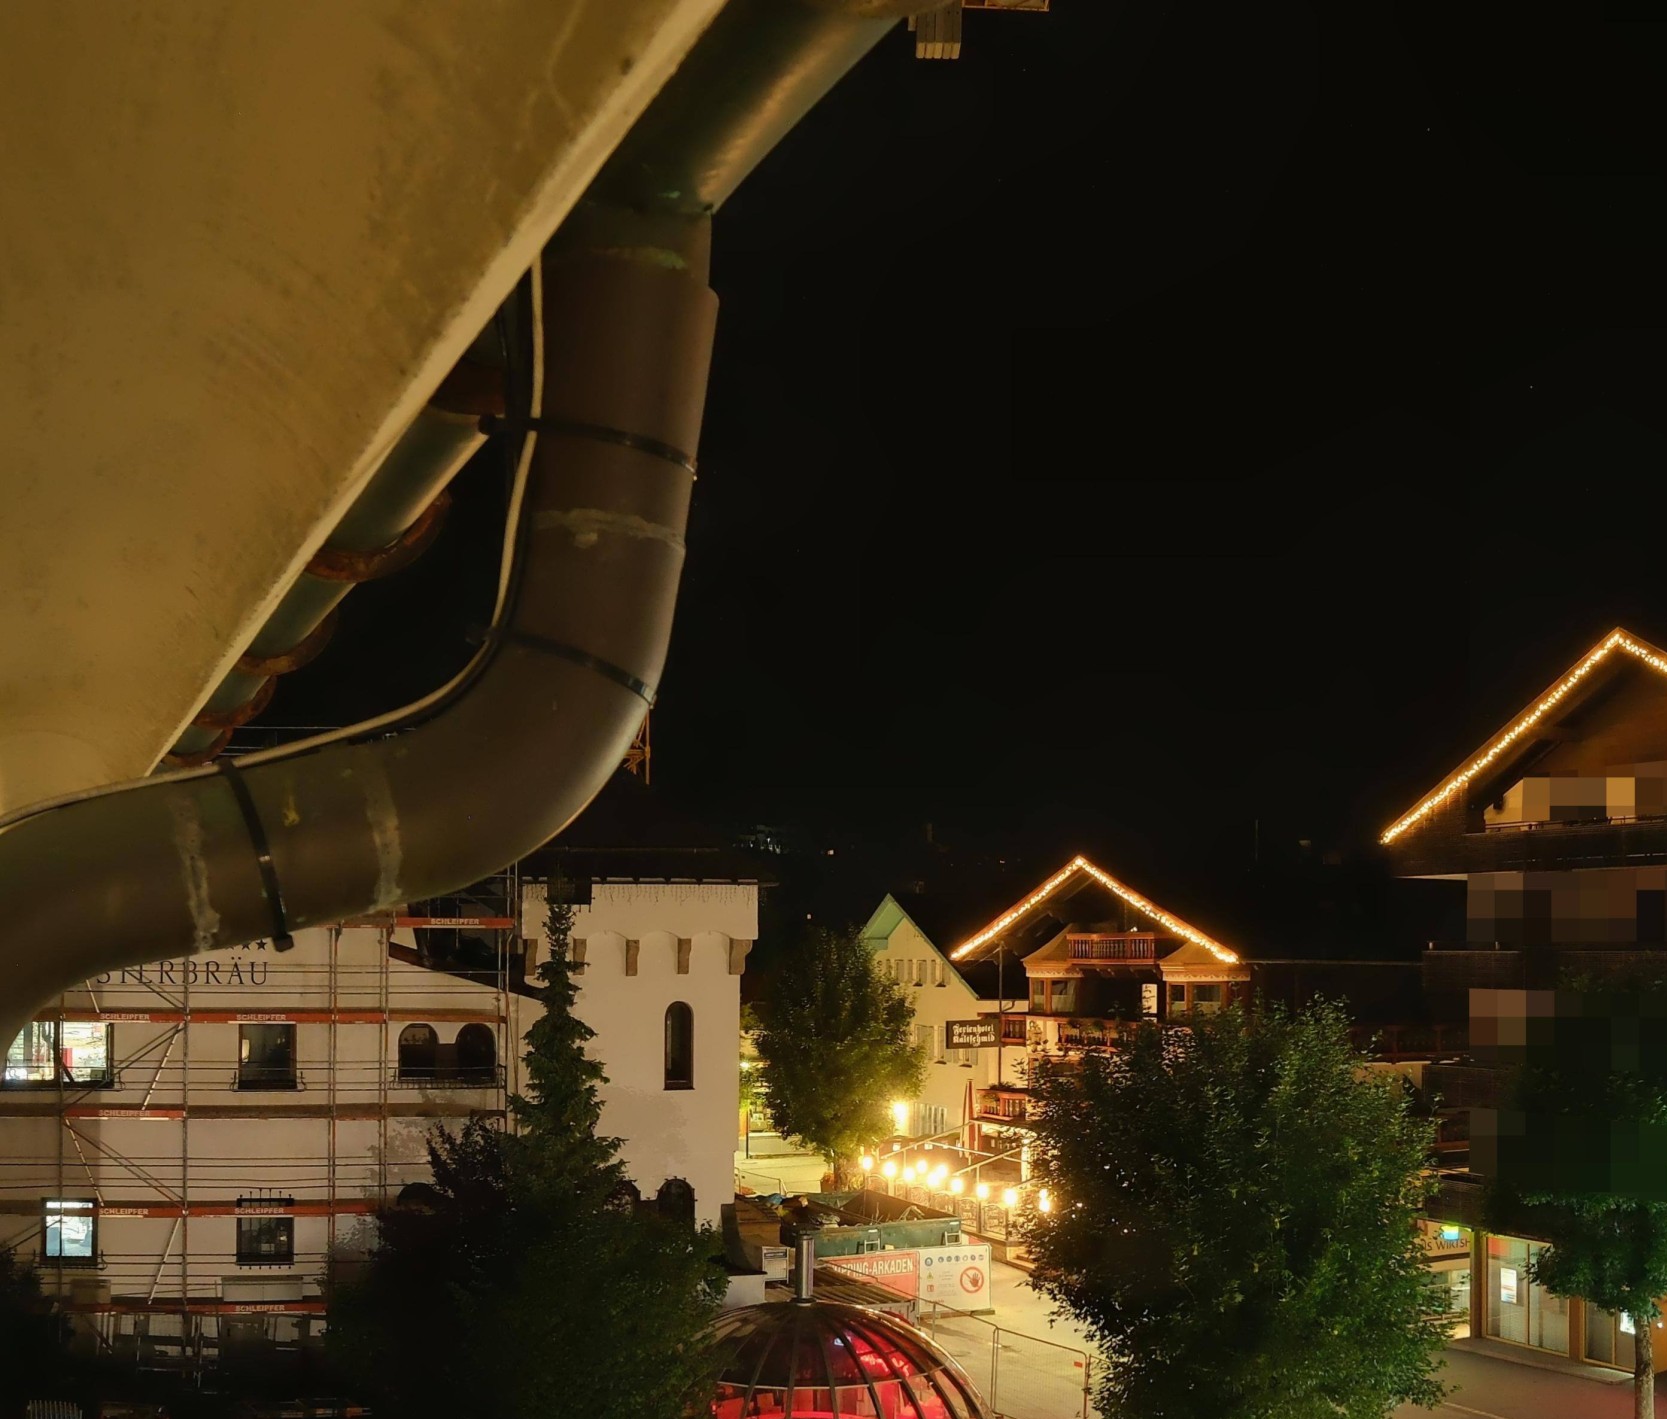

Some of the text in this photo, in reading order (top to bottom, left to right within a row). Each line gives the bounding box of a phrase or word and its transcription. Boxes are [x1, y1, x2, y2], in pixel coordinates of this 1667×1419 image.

[97, 956, 269, 985] STERBRÄU
[99, 1109, 150, 1117] SCHLEIPFER
[235, 1304, 285, 1312] SCHLEIPFER
